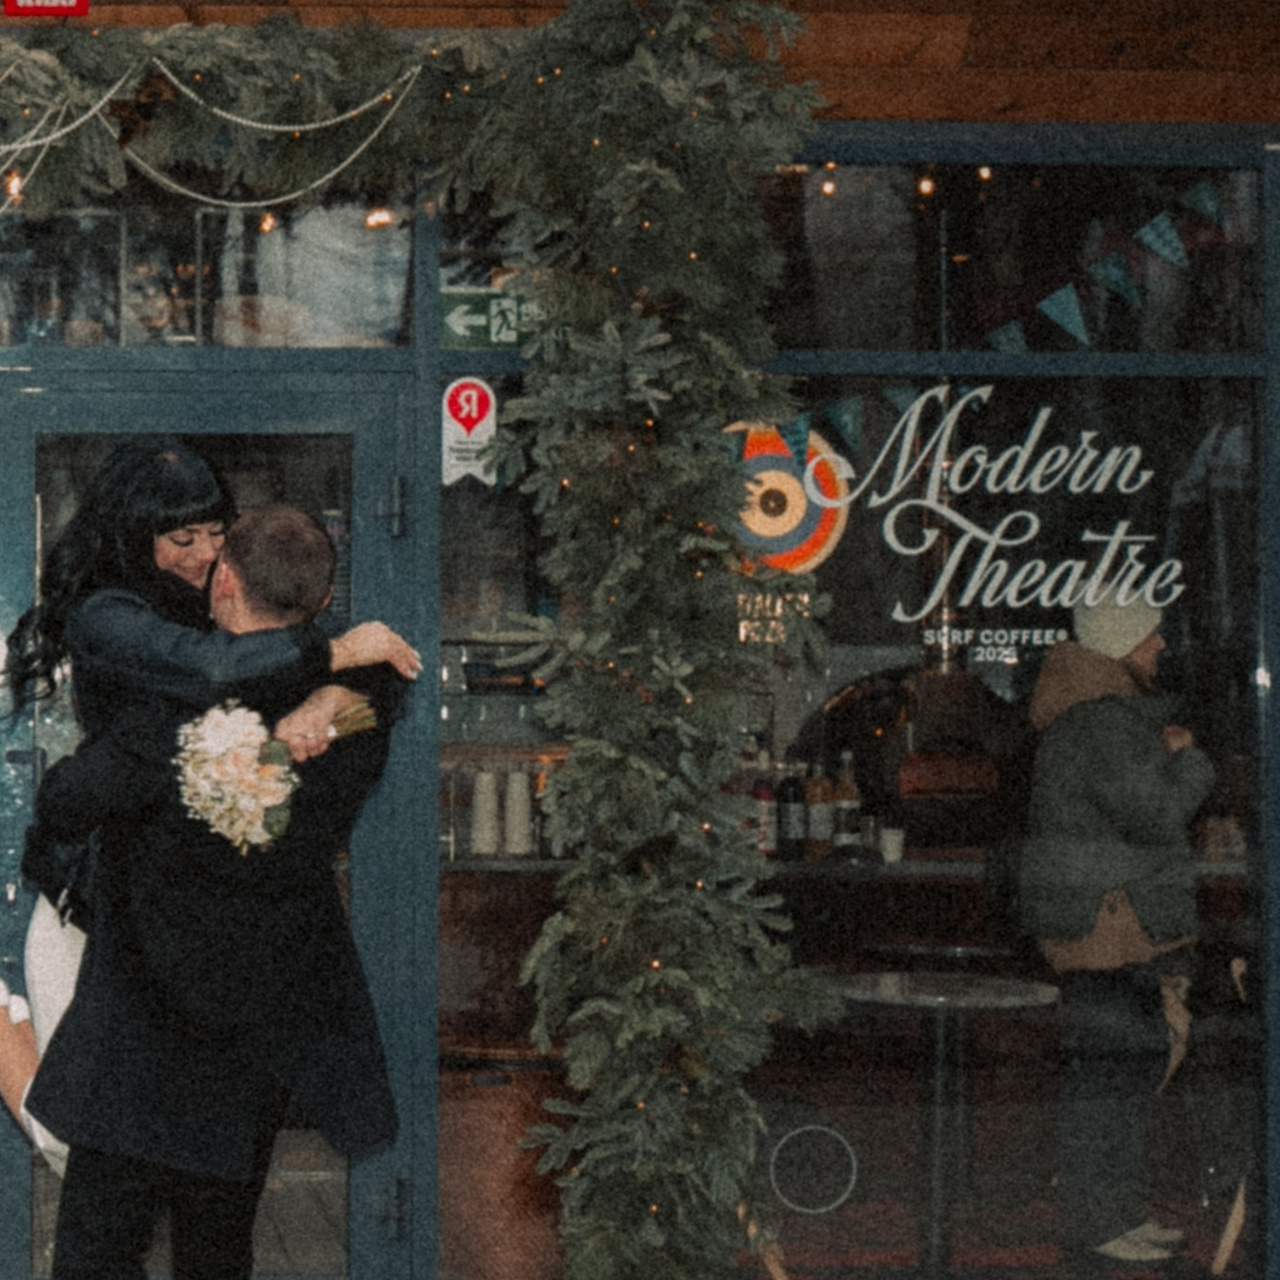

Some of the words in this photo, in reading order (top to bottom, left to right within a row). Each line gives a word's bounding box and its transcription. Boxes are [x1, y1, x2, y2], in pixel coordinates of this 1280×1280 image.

[804, 384, 1154, 508] Modern
[883, 499, 1186, 623] Theatre
[923, 629, 974, 645] SURF
